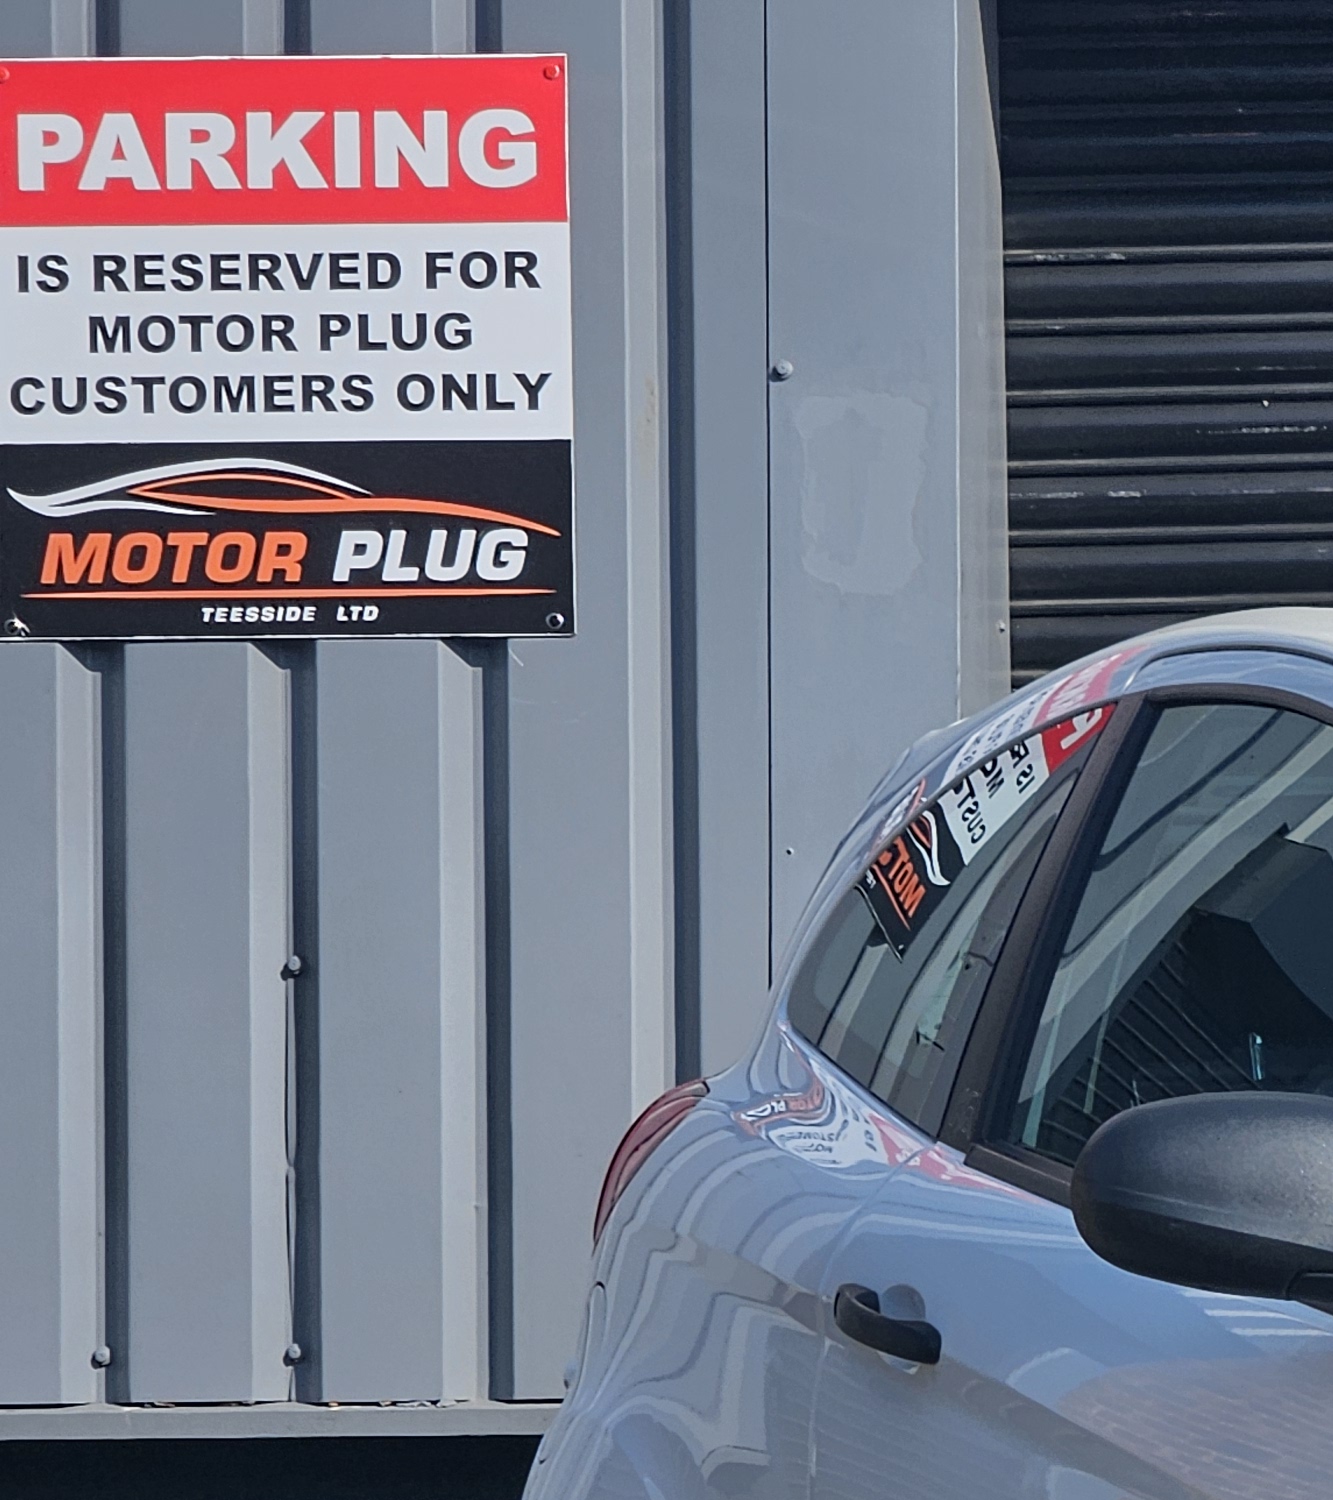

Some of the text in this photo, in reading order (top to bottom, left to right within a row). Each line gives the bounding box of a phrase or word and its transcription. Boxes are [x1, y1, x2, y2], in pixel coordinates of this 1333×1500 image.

[16, 109, 538, 192] PARKING
[16, 250, 542, 294] IS RESERVED FOR
[87, 311, 474, 354] MOTOR PLUG
[9, 371, 553, 416] CUSTOMERS ONLY
[40, 528, 530, 584] MOTOR PLUG
[200, 603, 380, 625] TEESSIDE LTD
